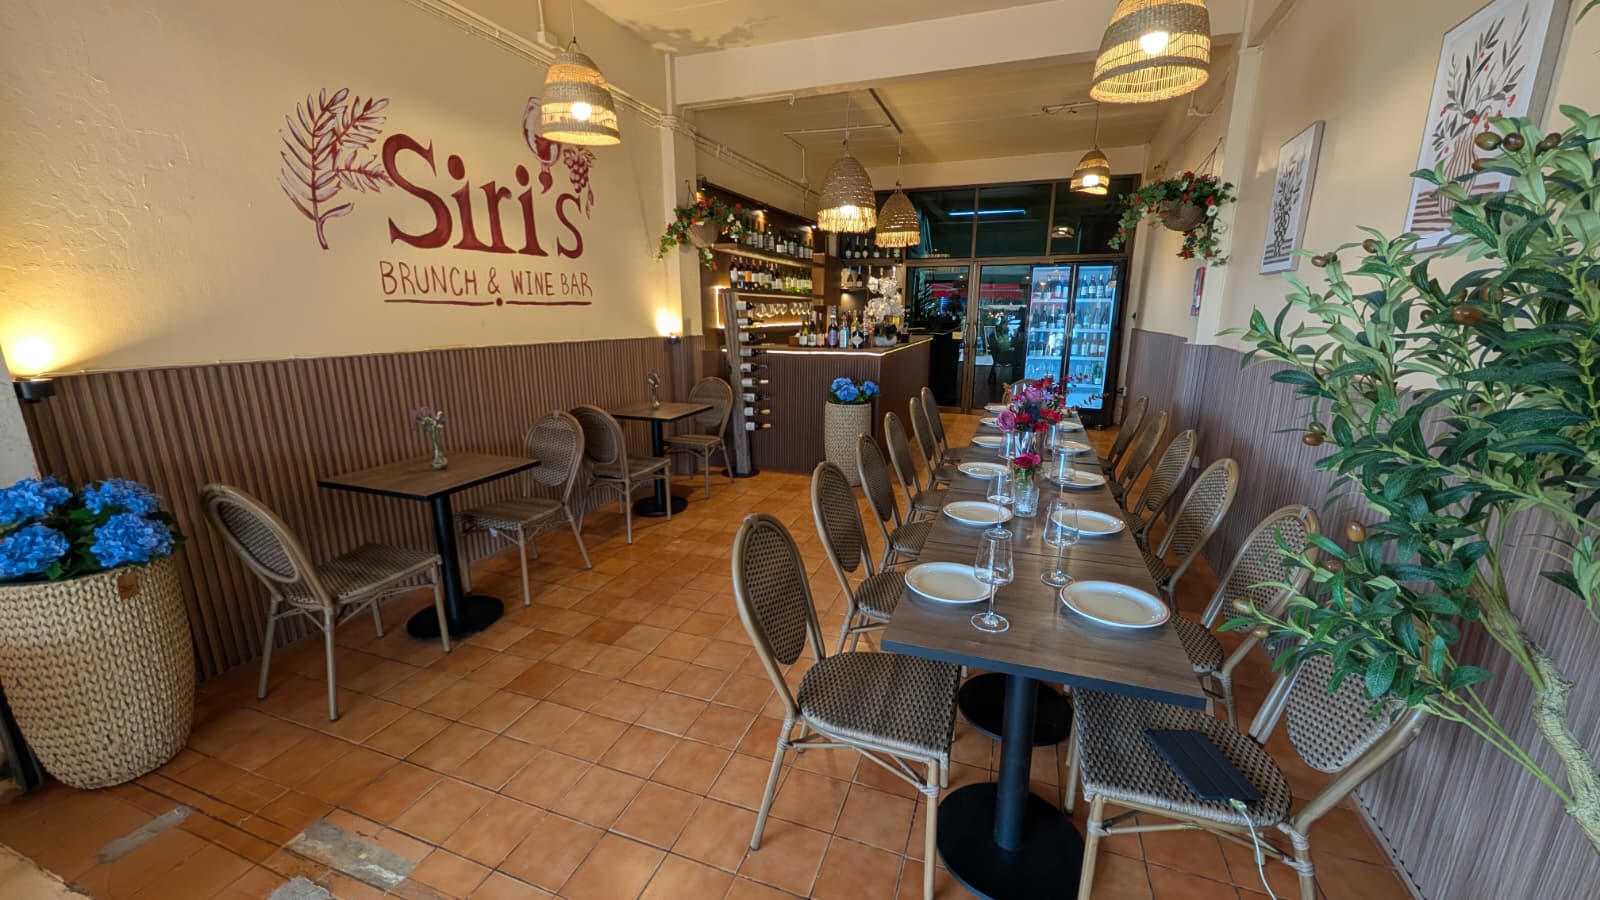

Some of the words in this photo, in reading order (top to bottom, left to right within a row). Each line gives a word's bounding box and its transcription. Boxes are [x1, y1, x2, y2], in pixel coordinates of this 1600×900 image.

[382, 133, 583, 259] Siri's
[379, 260, 477, 296] BRUNCH
[487, 266, 501, 294] &
[511, 270, 555, 296] WINE
[560, 271, 593, 297] BAR
